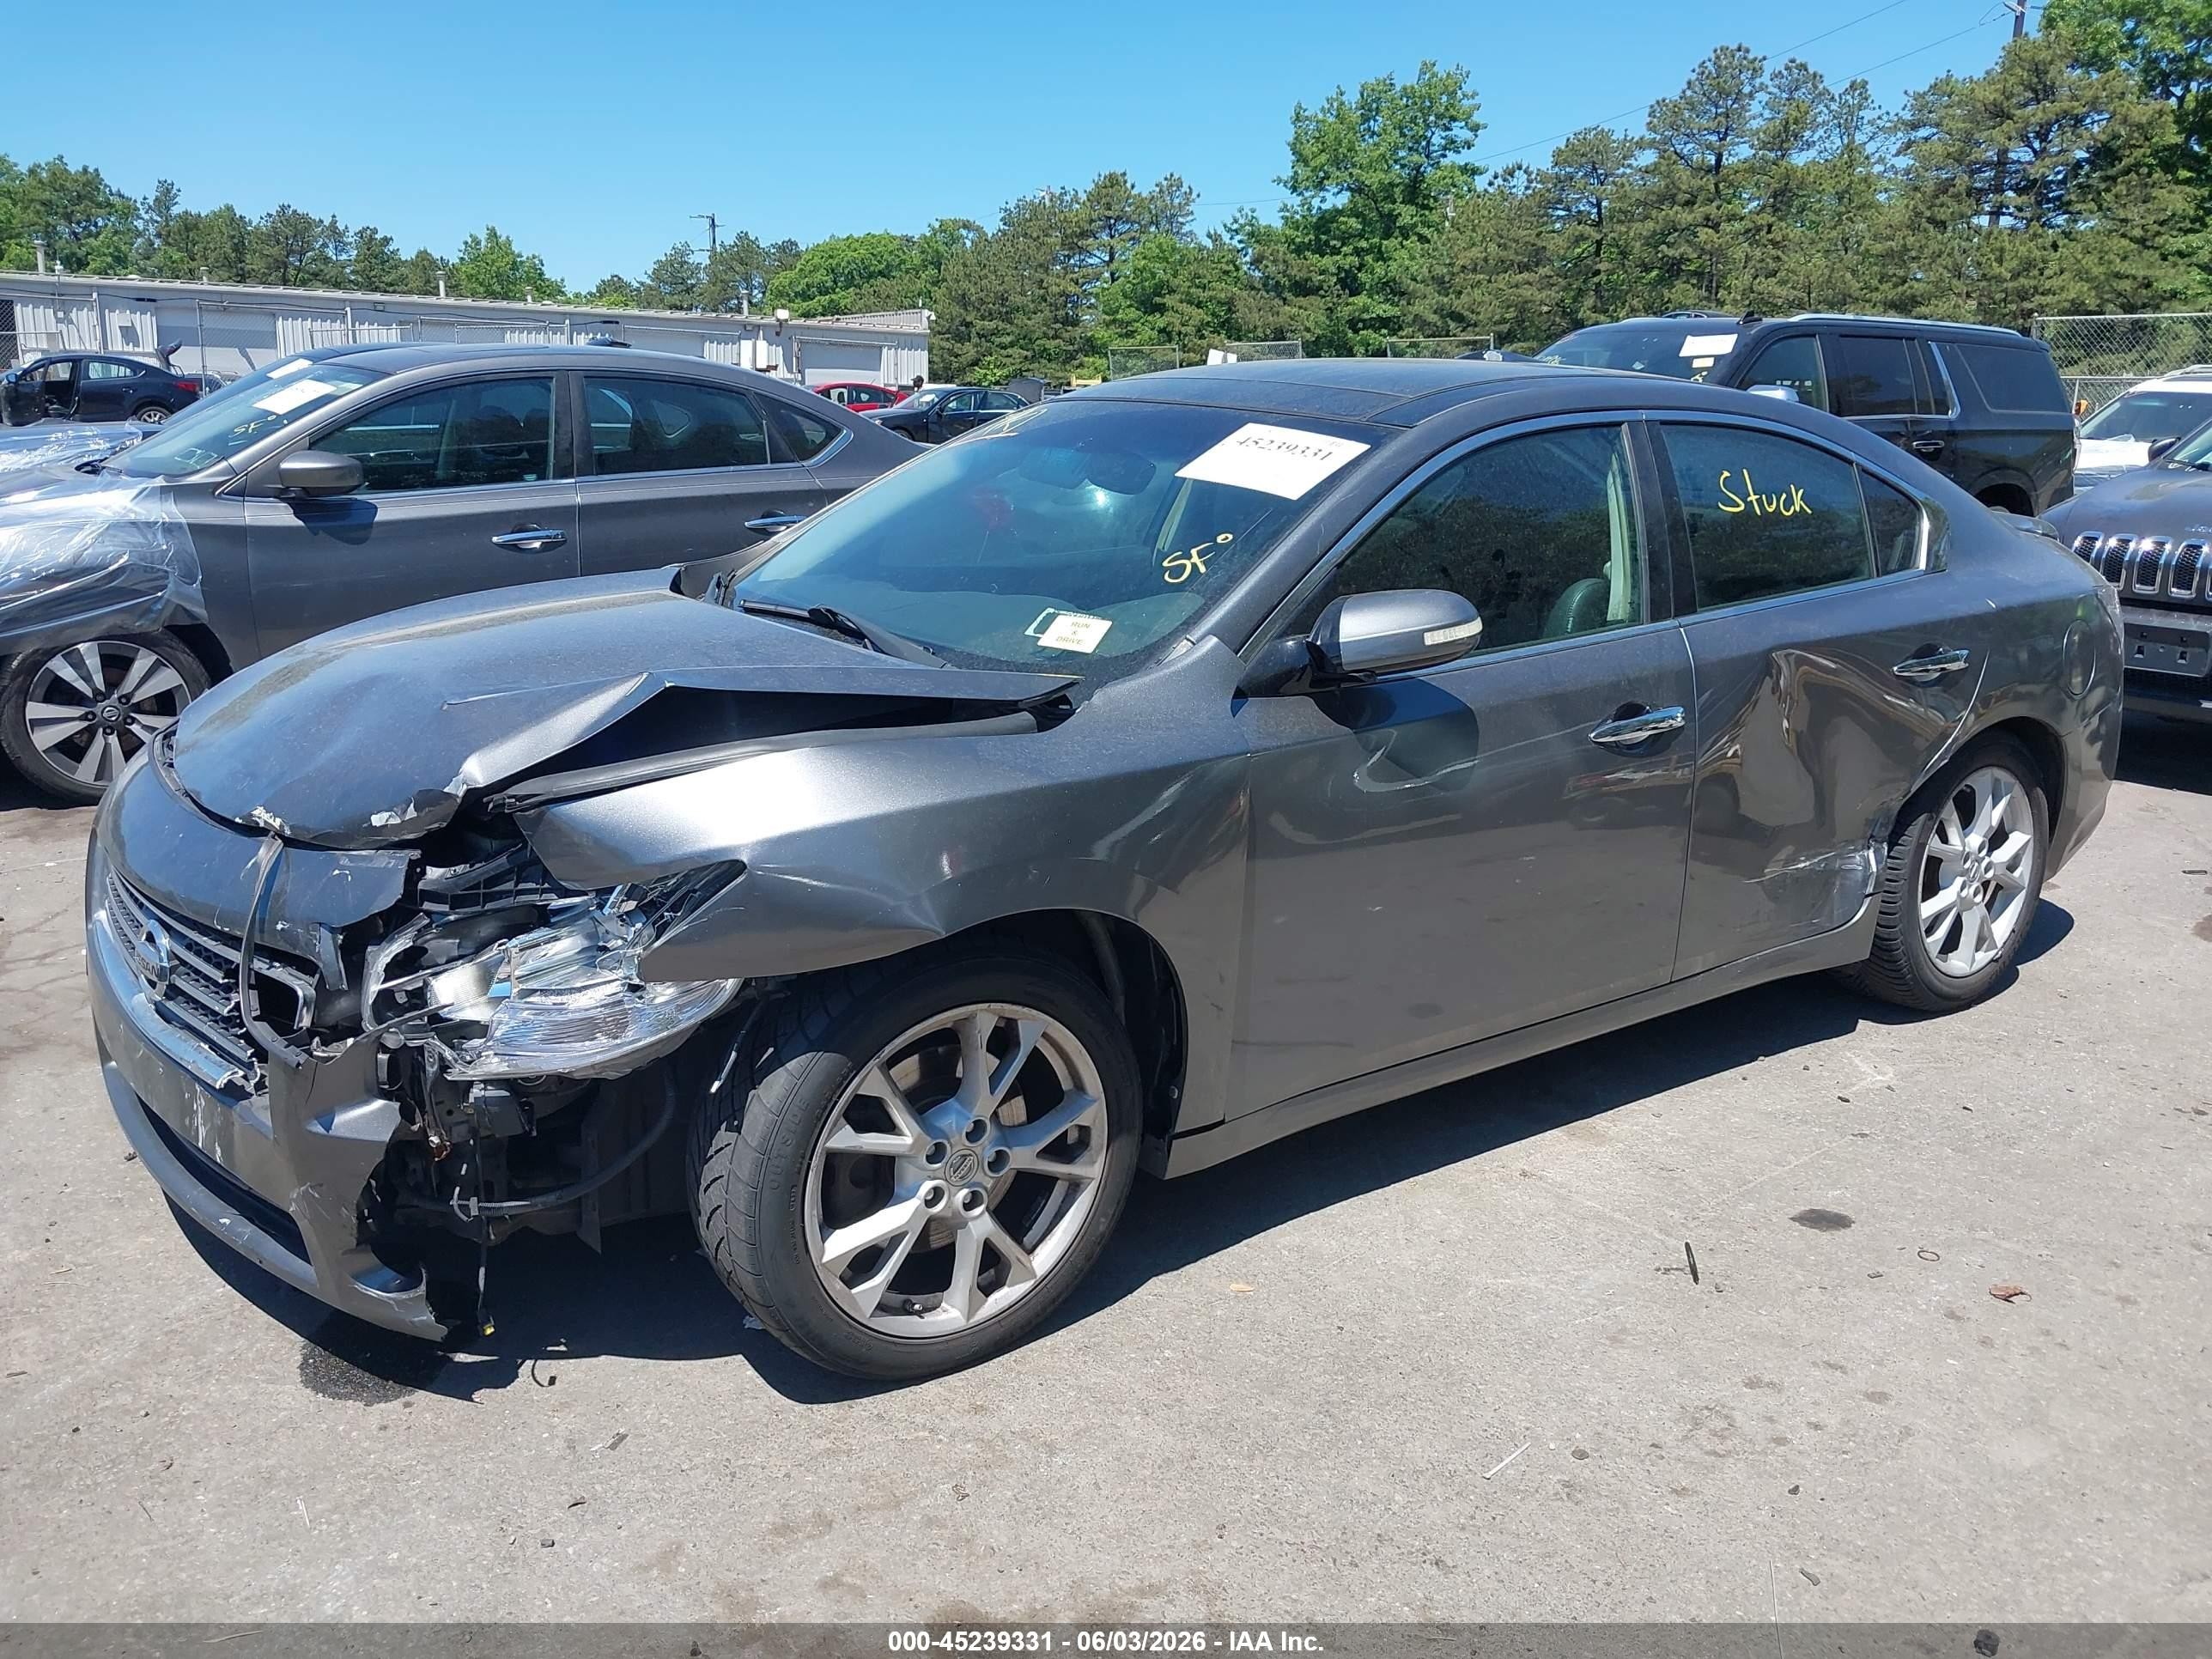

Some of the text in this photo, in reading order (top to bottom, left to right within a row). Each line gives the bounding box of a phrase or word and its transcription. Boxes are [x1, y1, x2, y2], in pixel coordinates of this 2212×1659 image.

[1237, 436, 1334, 460] 45239331
[1718, 468, 1813, 516] Stuck
[769, 1098, 811, 1191] OUTSIDE
